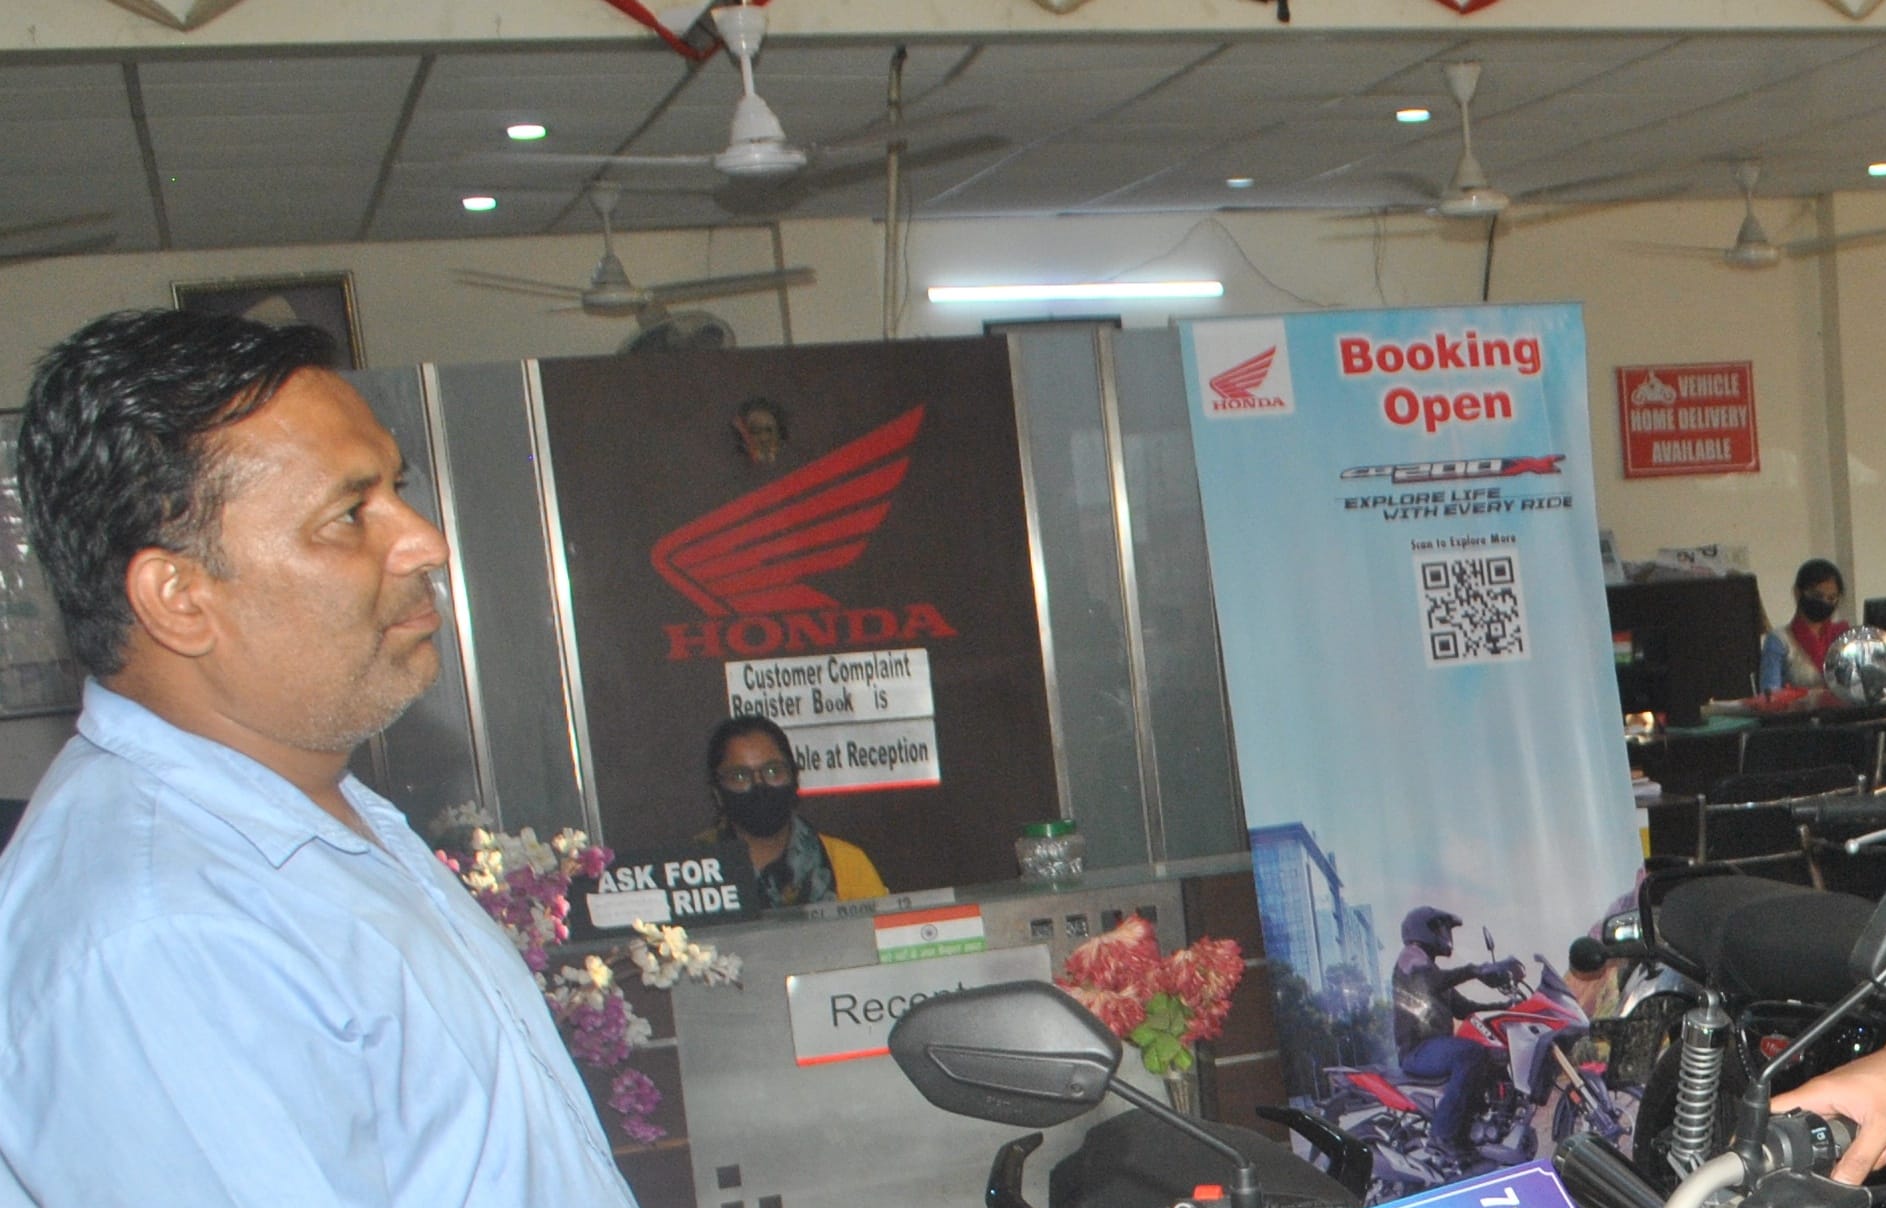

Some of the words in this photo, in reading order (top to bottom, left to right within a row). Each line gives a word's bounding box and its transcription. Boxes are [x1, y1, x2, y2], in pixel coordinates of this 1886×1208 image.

[1338, 331, 1542, 377] Booking
[1678, 373, 1740, 398] VEHICLE
[1213, 397, 1285, 411] HONDA
[1383, 386, 1512, 432] Open
[1630, 408, 1676, 432] HOME
[1678, 405, 1748, 430] DELIVERY
[1652, 437, 1732, 465] AVAILABLE
[1344, 491, 1445, 510] EXPLORE
[1452, 487, 1501, 502] LIFE
[1383, 506, 1437, 521] WITH
[1444, 499, 1515, 516] EVERY
[1521, 495, 1572, 511] RIDE
[1410, 538, 1433, 551] Scan
[1436, 538, 1447, 548] to
[1450, 534, 1486, 549] Explore
[1491, 532, 1516, 544] More
[667, 604, 957, 661] HONDA
[744, 663, 822, 691] Customer
[828, 651, 911, 686] Complaint
[812, 687, 854, 715] Book
[874, 684, 888, 710] is
[826, 748, 843, 769] at
[847, 739, 929, 771] Reception
[598, 862, 658, 894] ASK
[665, 857, 724, 888] FOR
[671, 884, 741, 917] RIDE
